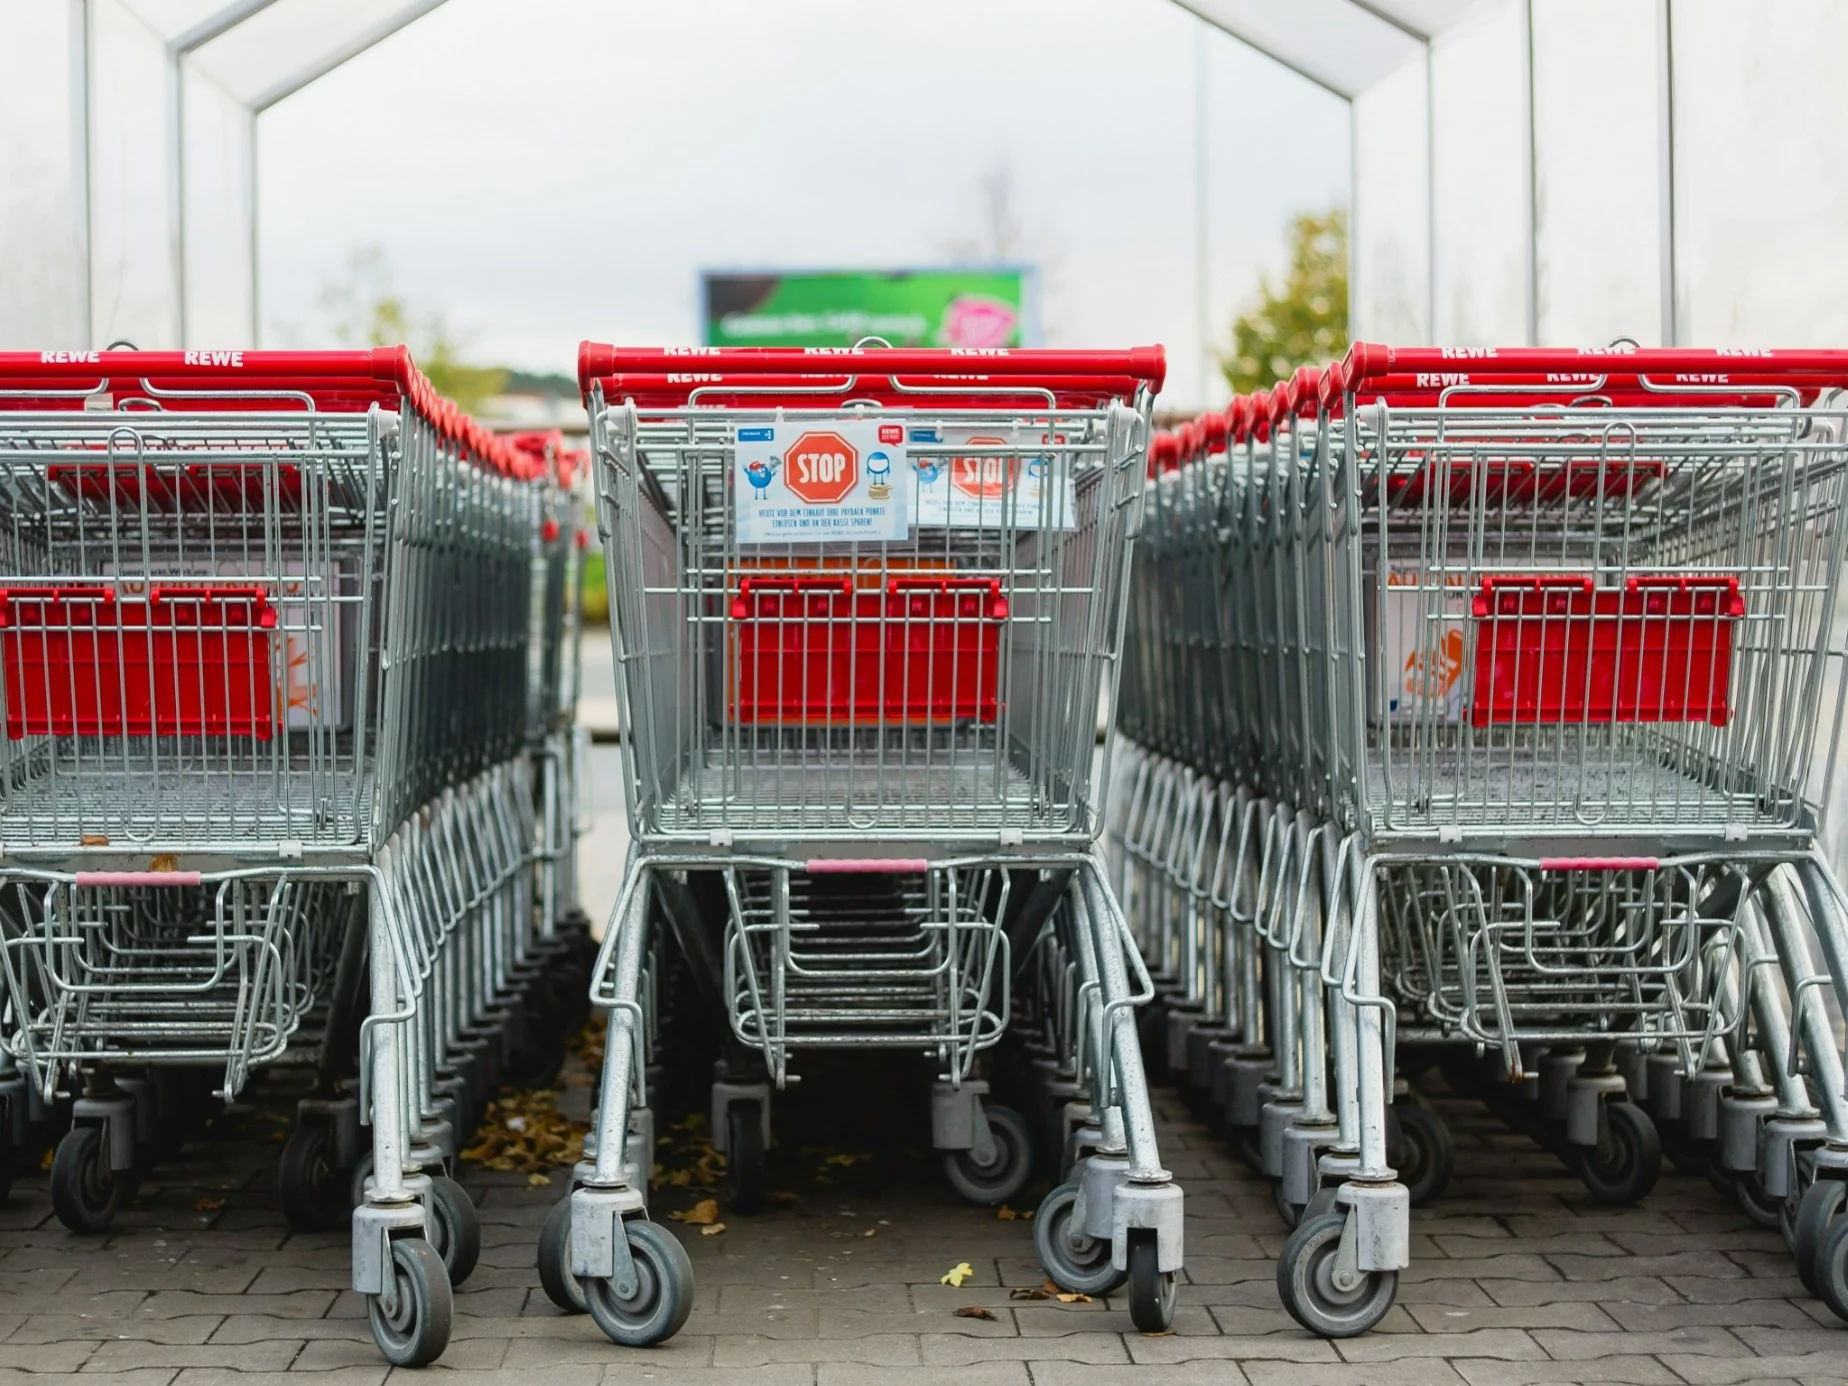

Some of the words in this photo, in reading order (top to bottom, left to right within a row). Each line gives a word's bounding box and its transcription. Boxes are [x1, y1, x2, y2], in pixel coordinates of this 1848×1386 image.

[41, 350, 100, 364] REWE
[184, 350, 244, 368] REWE
[1441, 346, 1499, 359] REWE
[1716, 346, 1773, 357] REWE
[1416, 373, 1470, 388] REWE
[797, 453, 846, 484] STOP
[758, 509, 775, 518] HEUTE
[777, 509, 787, 517] VOR
[790, 508, 801, 517] DEM
[803, 508, 824, 516] EINKAUF
[840, 508, 863, 516] PAYBACK
[866, 507, 885, 516] PUNKTE
[799, 519, 810, 527] UND
[812, 519, 819, 527] AN
[821, 518, 831, 527] DER
[833, 518, 849, 527] KASSE
